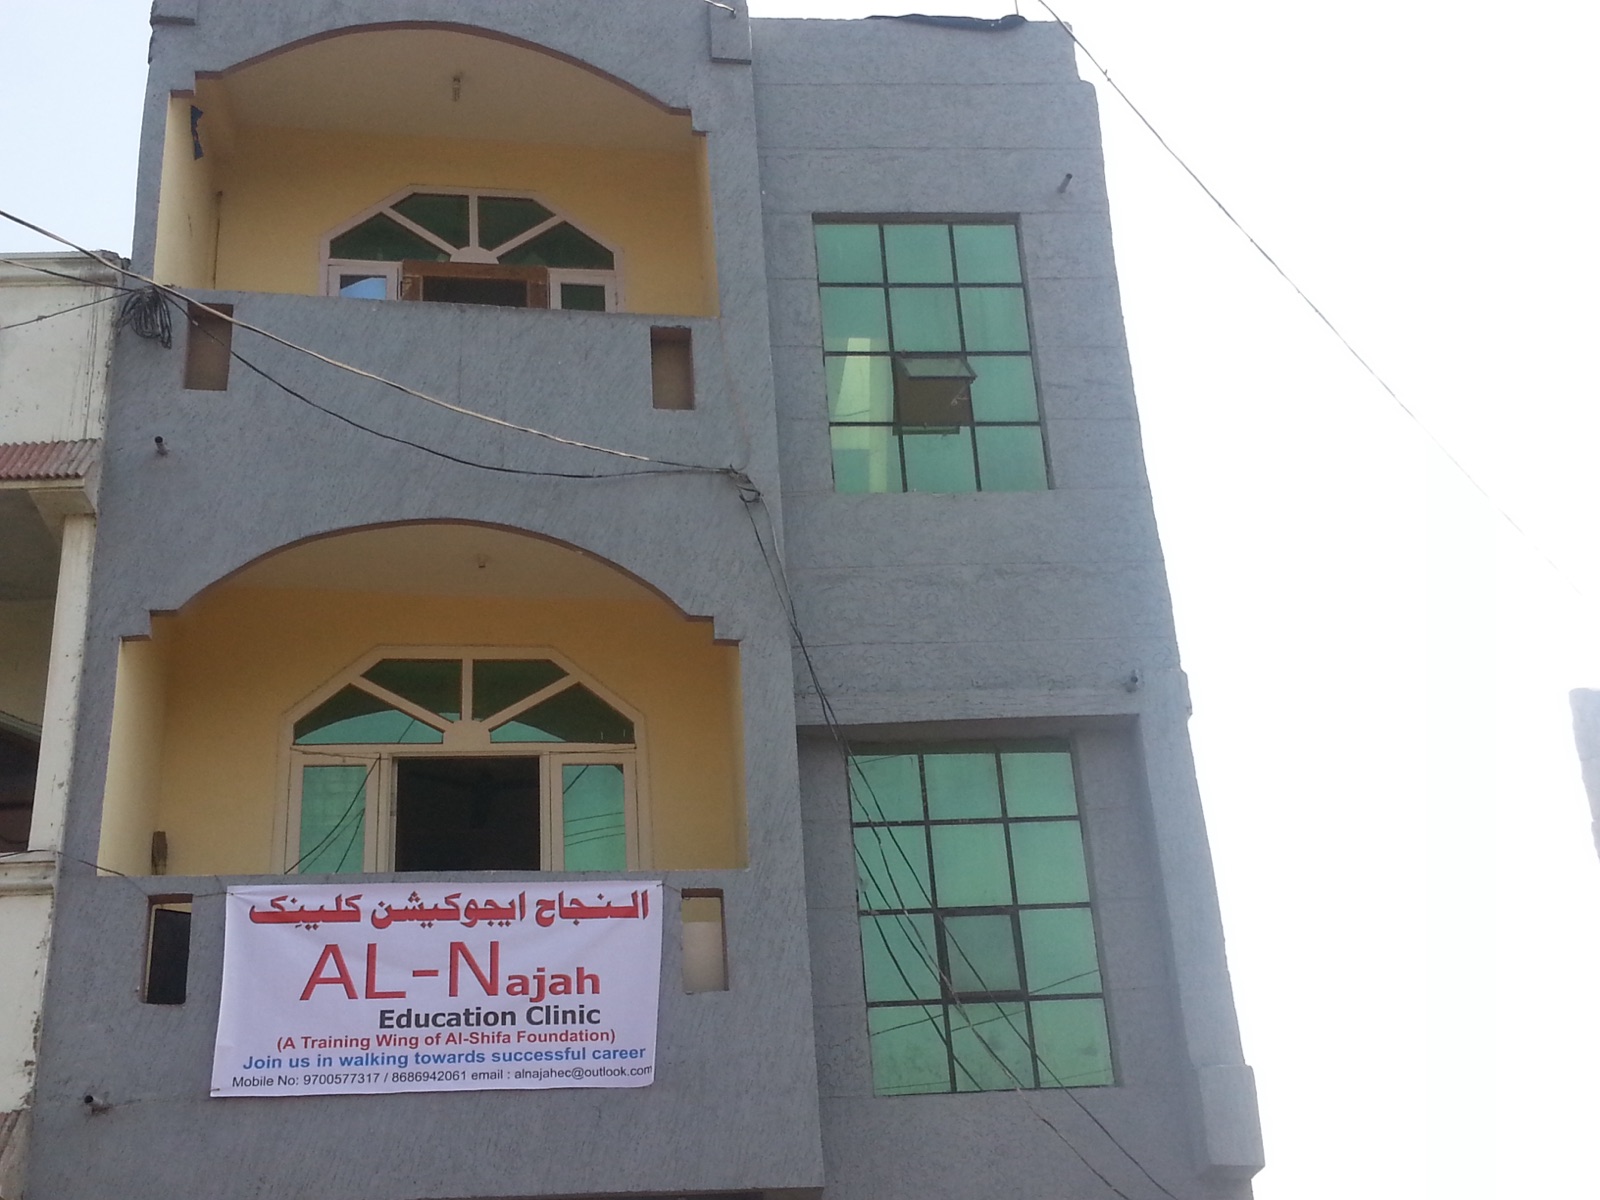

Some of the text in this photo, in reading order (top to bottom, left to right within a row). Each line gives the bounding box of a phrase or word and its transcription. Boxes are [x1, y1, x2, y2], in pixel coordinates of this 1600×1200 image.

[379, 1004, 601, 1029] Education Clinic
[277, 1028, 616, 1053] (A Training Wing of Al-Shifa Foundation)
[243, 1047, 646, 1070] Join us in walking towards successful career
[232, 1075, 274, 1088] Mobile
[277, 1074, 299, 1086] No:
[303, 1072, 380, 1086] 9700577317
[391, 1069, 466, 1083] 8686942061
[471, 1068, 504, 1081] email
[514, 1065, 653, 1081] alnajahec@outlook.com
